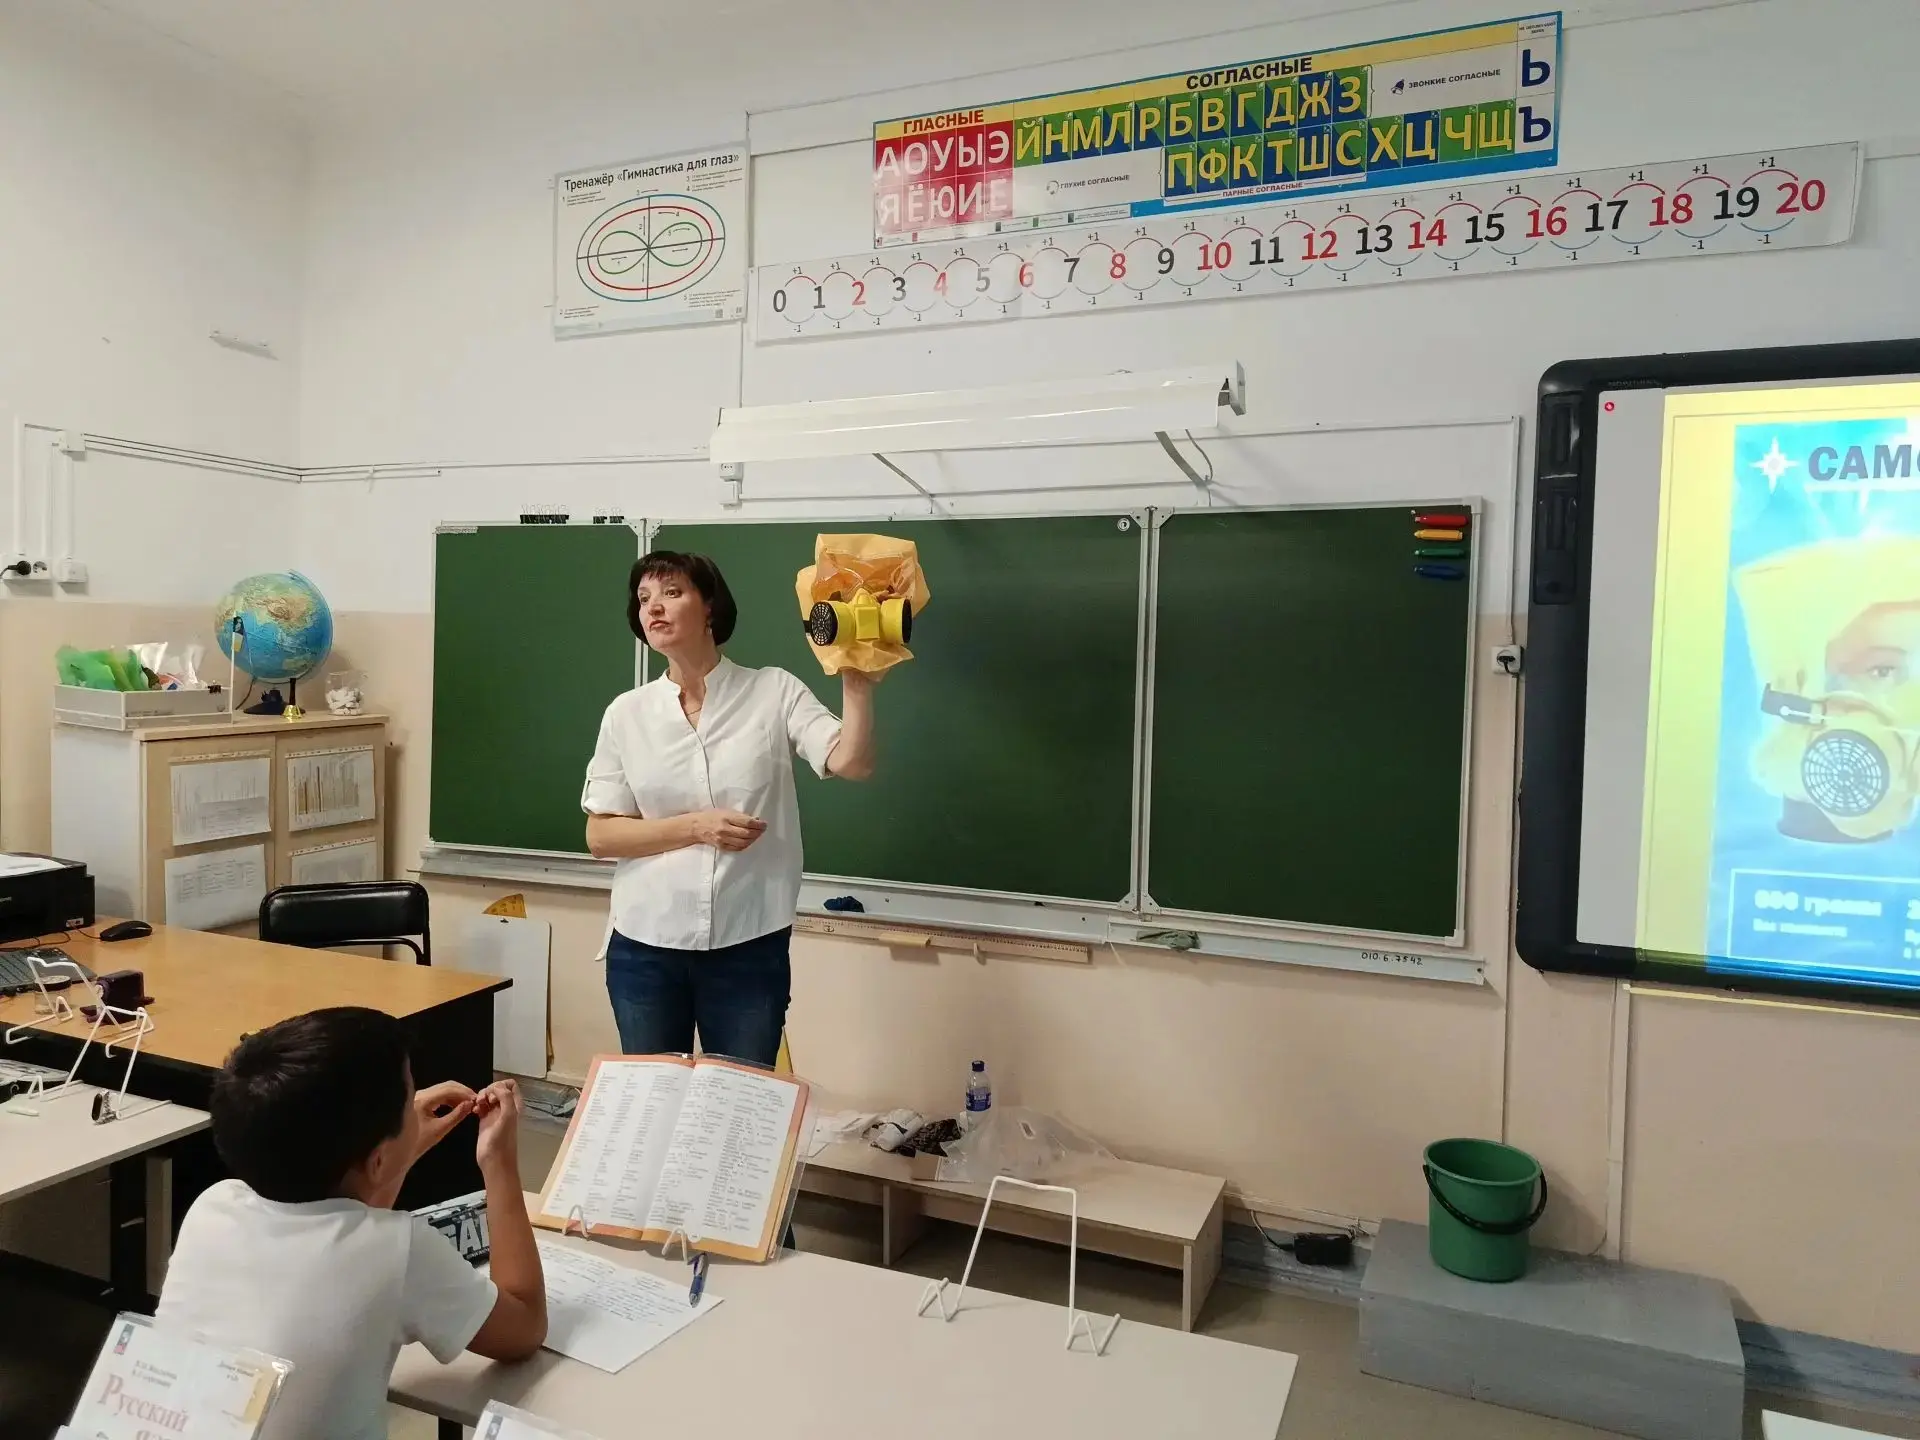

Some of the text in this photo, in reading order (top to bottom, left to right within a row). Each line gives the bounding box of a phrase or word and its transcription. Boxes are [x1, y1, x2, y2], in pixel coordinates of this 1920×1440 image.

[1186, 56, 1312, 90] СОГЛАСНЫЕ
[1408, 68, 1501, 89] ЗВОНКИЕ СОГЛАСНЫЕ
[903, 109, 984, 134] ГЛАСНЫЕ
[565, 174, 614, 191] Тренажёр
[617, 163, 683, 182] «Гимнастика
[687, 158, 707, 172] для
[710, 153, 739, 166] глаз»
[1060, 174, 1130, 189] ГЛУХИЕ СОГЛАСНЫЕ
[1222, 181, 1303, 197] ПАРНЫЕ СОГЛАСНЫЕ
[792, 157, 1776, 275] +1 +1 +1 +1 +1 +1 +1 +1 +1 +1 +1 +1 +1 +1 +1 +1 +1 +1 +1 +1
[773, 289, 787, 312] 0
[813, 286, 825, 309] 1
[852, 282, 866, 305] 2
[892, 277, 906, 301] 3
[933, 272, 947, 297] 4
[976, 268, 990, 292] 5
[1019, 262, 1033, 287] 6
[1064, 258, 1080, 282] 7
[1110, 252, 1126, 278] 8
[1157, 248, 1174, 274] 9
[1197, 241, 1232, 271] 10
[1249, 236, 1284, 265] 11
[1301, 230, 1338, 260] 12
[1355, 224, 1393, 255] 13
[1407, 219, 1447, 249] 14
[1465, 213, 1504, 243] 15
[1525, 206, 1567, 238] 16
[1585, 200, 1628, 232] 17
[1649, 193, 1693, 226] 18
[1713, 186, 1759, 220] 19
[1776, 179, 1825, 214] 20
[998, 305, 1007, 313] -1
[1041, 301, 1051, 309] -1
[1088, 297, 1096, 305] -1
[1134, 292, 1143, 300] -1
[1182, 288, 1193, 296] -1
[1232, 283, 1242, 292] -1
[1284, 278, 1294, 287] -1
[1337, 273, 1347, 282] -1
[1392, 267, 1402, 276] -1
[1448, 262, 1459, 271] -1
[1505, 256, 1518, 266] -1
[1565, 251, 1578, 261] -1
[1628, 245, 1640, 255] -1
[1692, 240, 1704, 250] -1
[1757, 234, 1771, 244] -1
[1809, 444, 1920, 481] САМ
[97, 1373, 189, 1433] Русский
